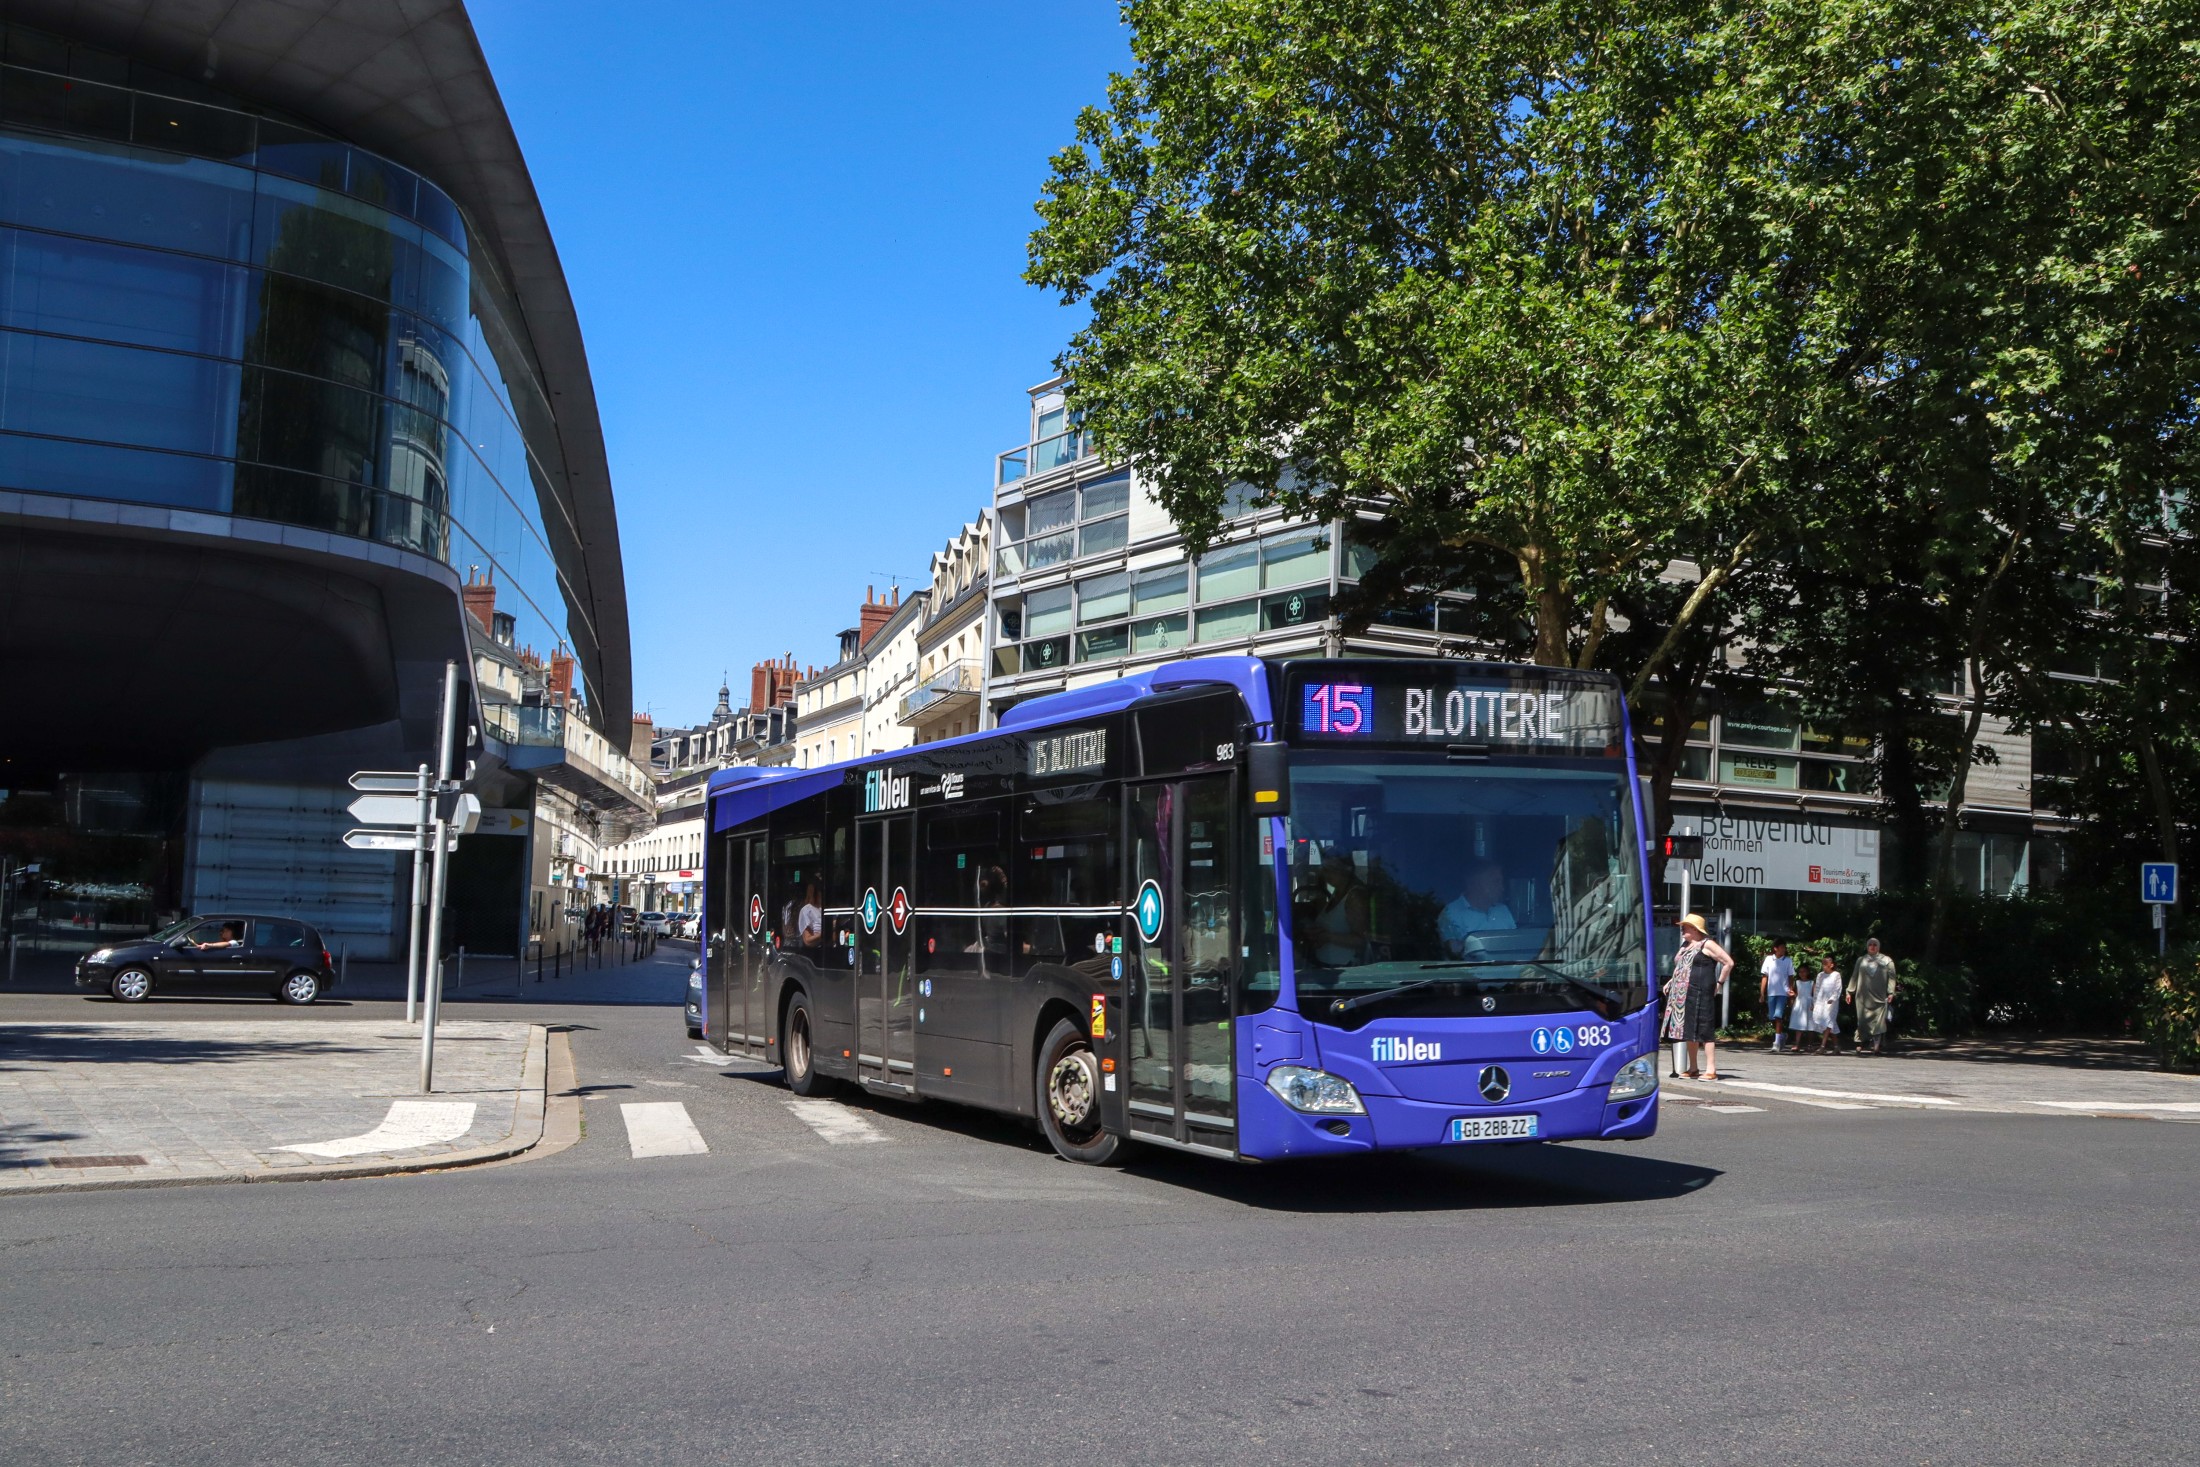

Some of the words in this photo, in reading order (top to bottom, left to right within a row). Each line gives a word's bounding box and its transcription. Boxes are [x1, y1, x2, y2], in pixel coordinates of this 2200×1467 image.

[1311, 685, 1364, 733] 15
[1405, 687, 1564, 739] BLOTTERIE
[1216, 742, 1235, 762] 983
[1734, 754, 1778, 770] PRELYS
[865, 770, 910, 813] filbleu
[1823, 877, 1839, 885] TOURS
[1371, 1036, 1441, 1062] filbleu
[1577, 1025, 1612, 1047] 983
[1464, 1119, 1526, 1138] GB-288-ZZ
